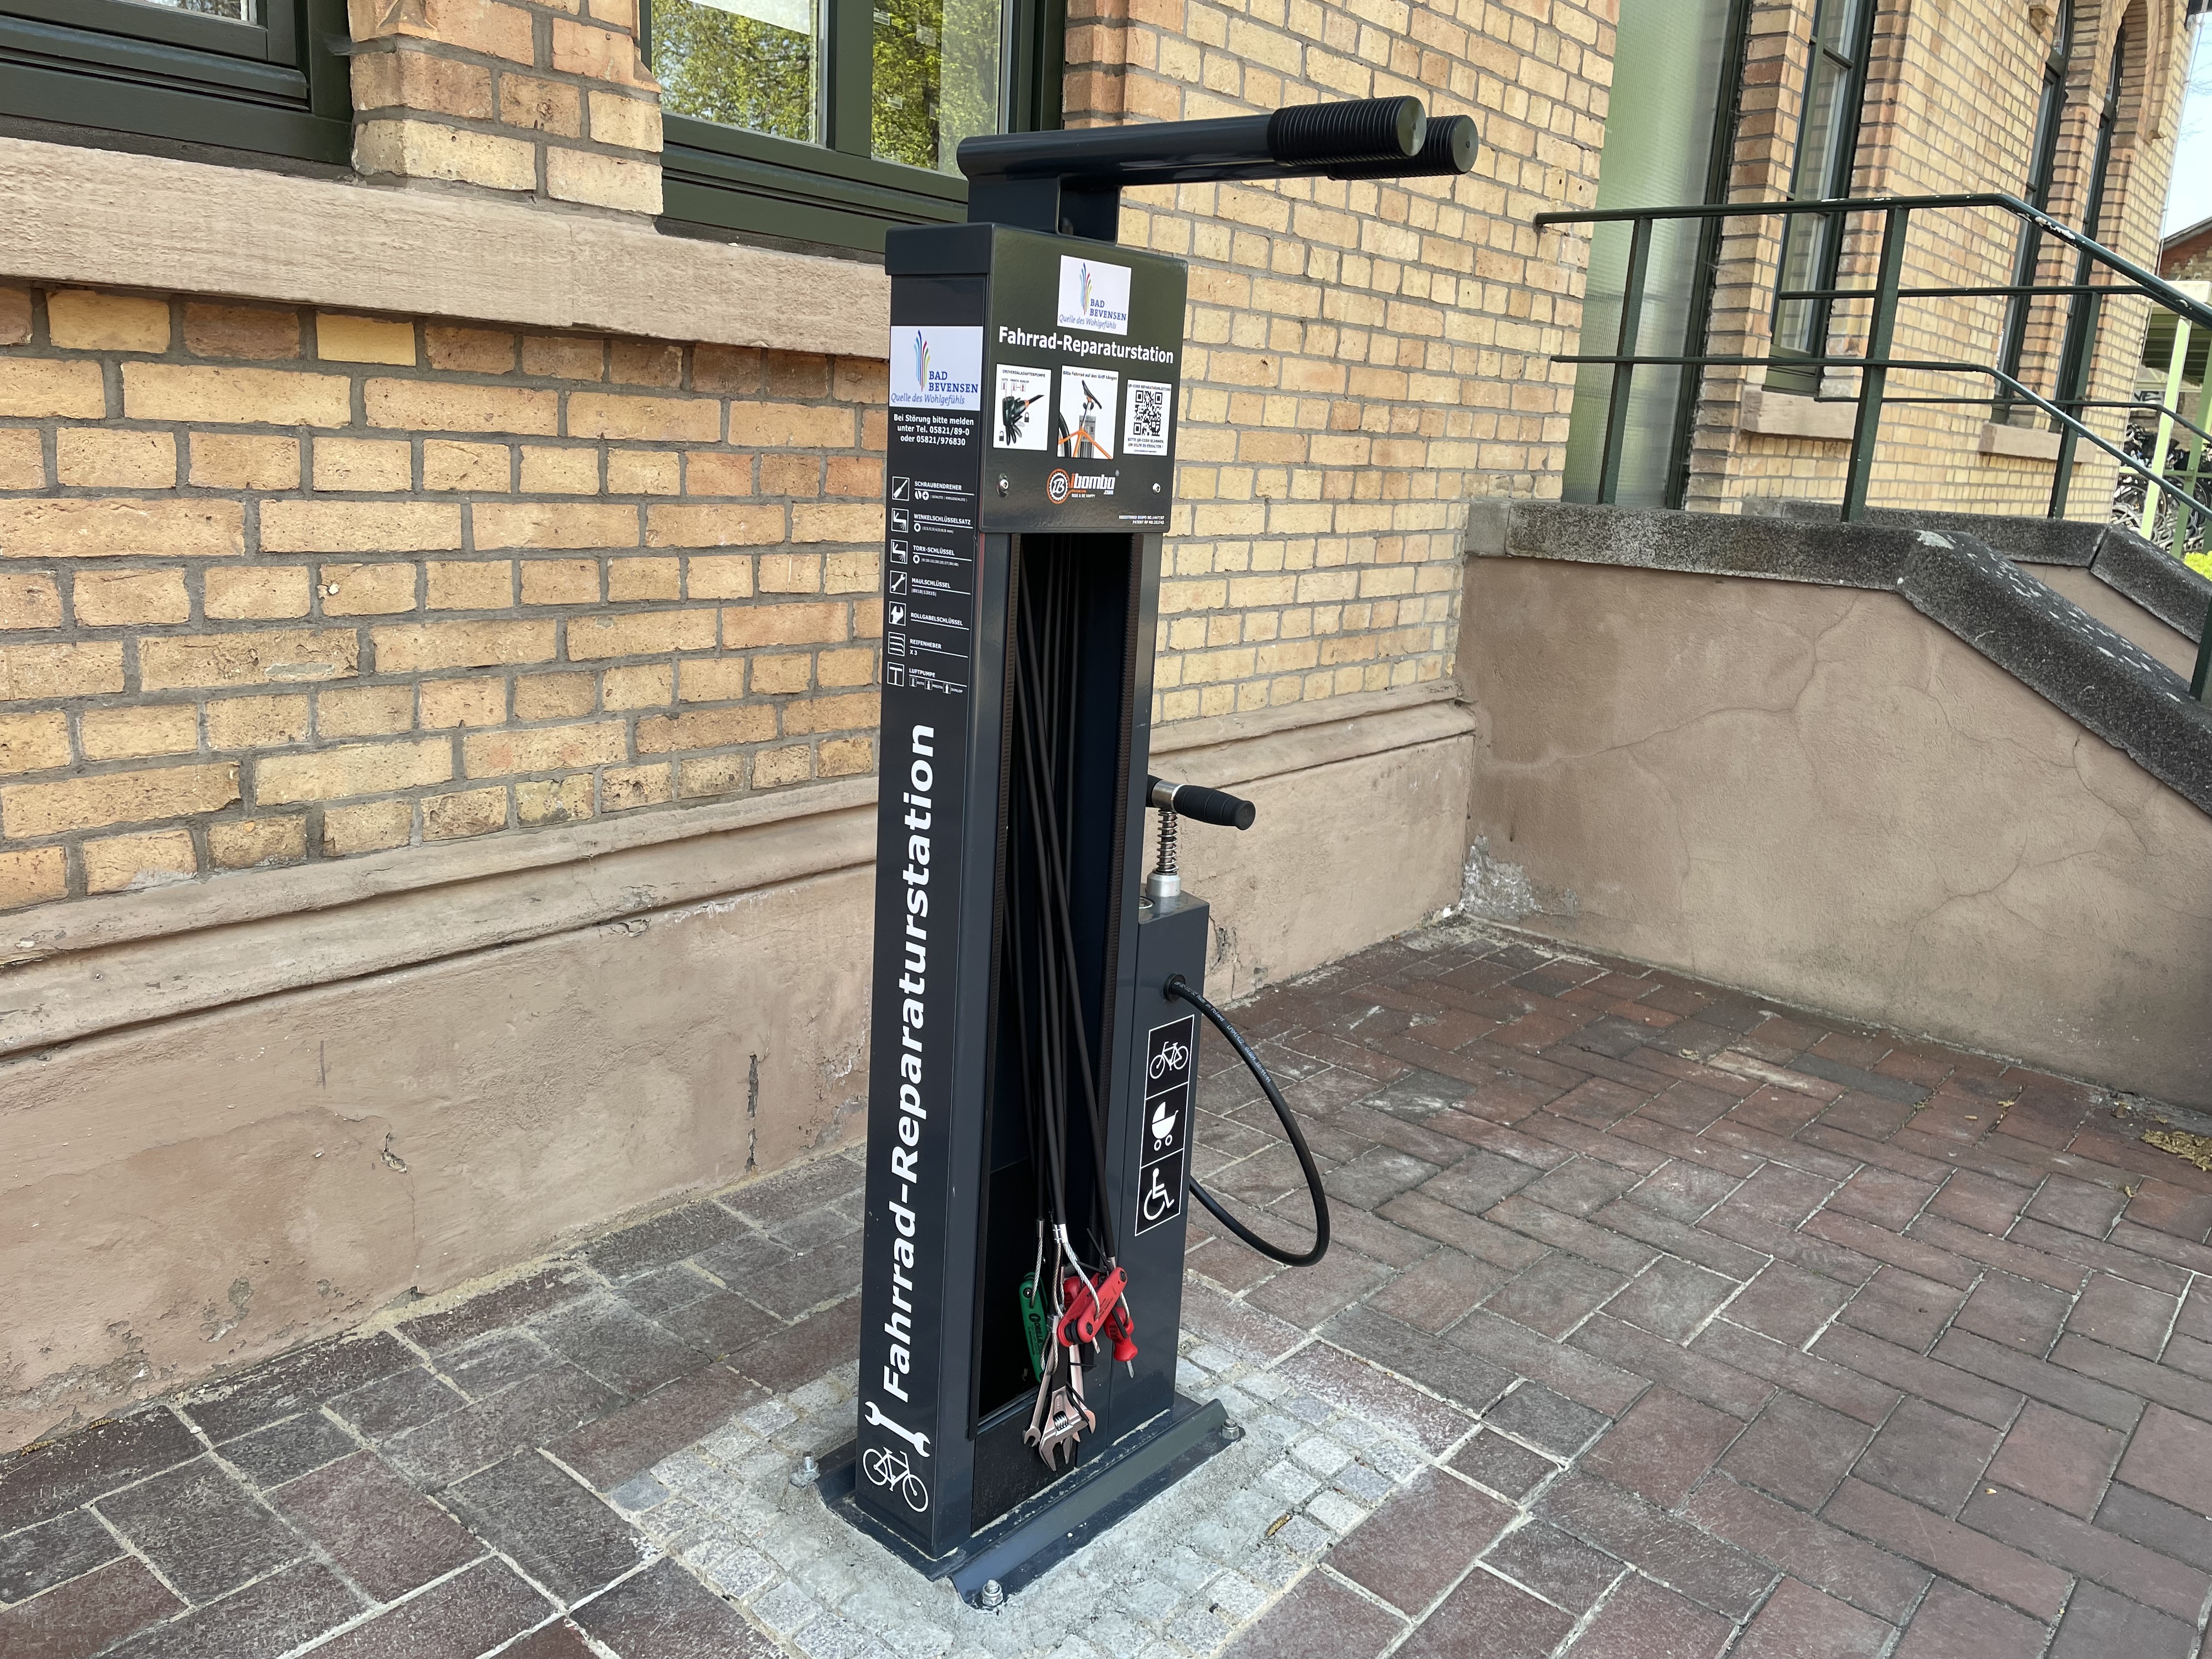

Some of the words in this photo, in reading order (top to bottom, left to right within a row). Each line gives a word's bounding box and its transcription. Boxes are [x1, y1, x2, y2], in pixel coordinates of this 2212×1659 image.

[1090, 298, 1104, 308] BAD
[1090, 308, 1126, 321] BEVENSEN
[1059, 314, 1075, 323] Quelle
[1076, 316, 1085, 324] des
[1086, 318, 1116, 330] Wohlgefühls
[998, 325, 1174, 364] Fahrrad-Reparaturstation
[929, 371, 947, 380] BAD
[928, 382, 978, 393] BEVENSEN
[891, 393, 911, 403] Quelle
[912, 393, 922, 402] des
[924, 394, 965, 406] Wohlgefühls
[905, 414, 930, 424] Störung
[933, 415, 948, 424] bitte
[950, 417, 974, 425] melden
[929, 426, 969, 436] 05821/89-0
[917, 435, 966, 445] 05821/976830
[915, 481, 962, 490] SCHRAUBENDREHER
[913, 513, 971, 525] WINKELSCHLÜSSELSATZ
[913, 545, 955, 556] TORX-SCHLÜSSEL
[912, 578, 951, 589] MAULSCHLÜSSEL
[911, 612, 963, 626] ROLLGABELSCHLÜSSEL
[910, 639, 942, 649] REIFENHEBER
[909, 668, 935, 678] LUFTPUMPE
[1211, 1007, 1225, 1022] Poland
[883, 725, 934, 1403] Fahrrad-Reparaturstation
